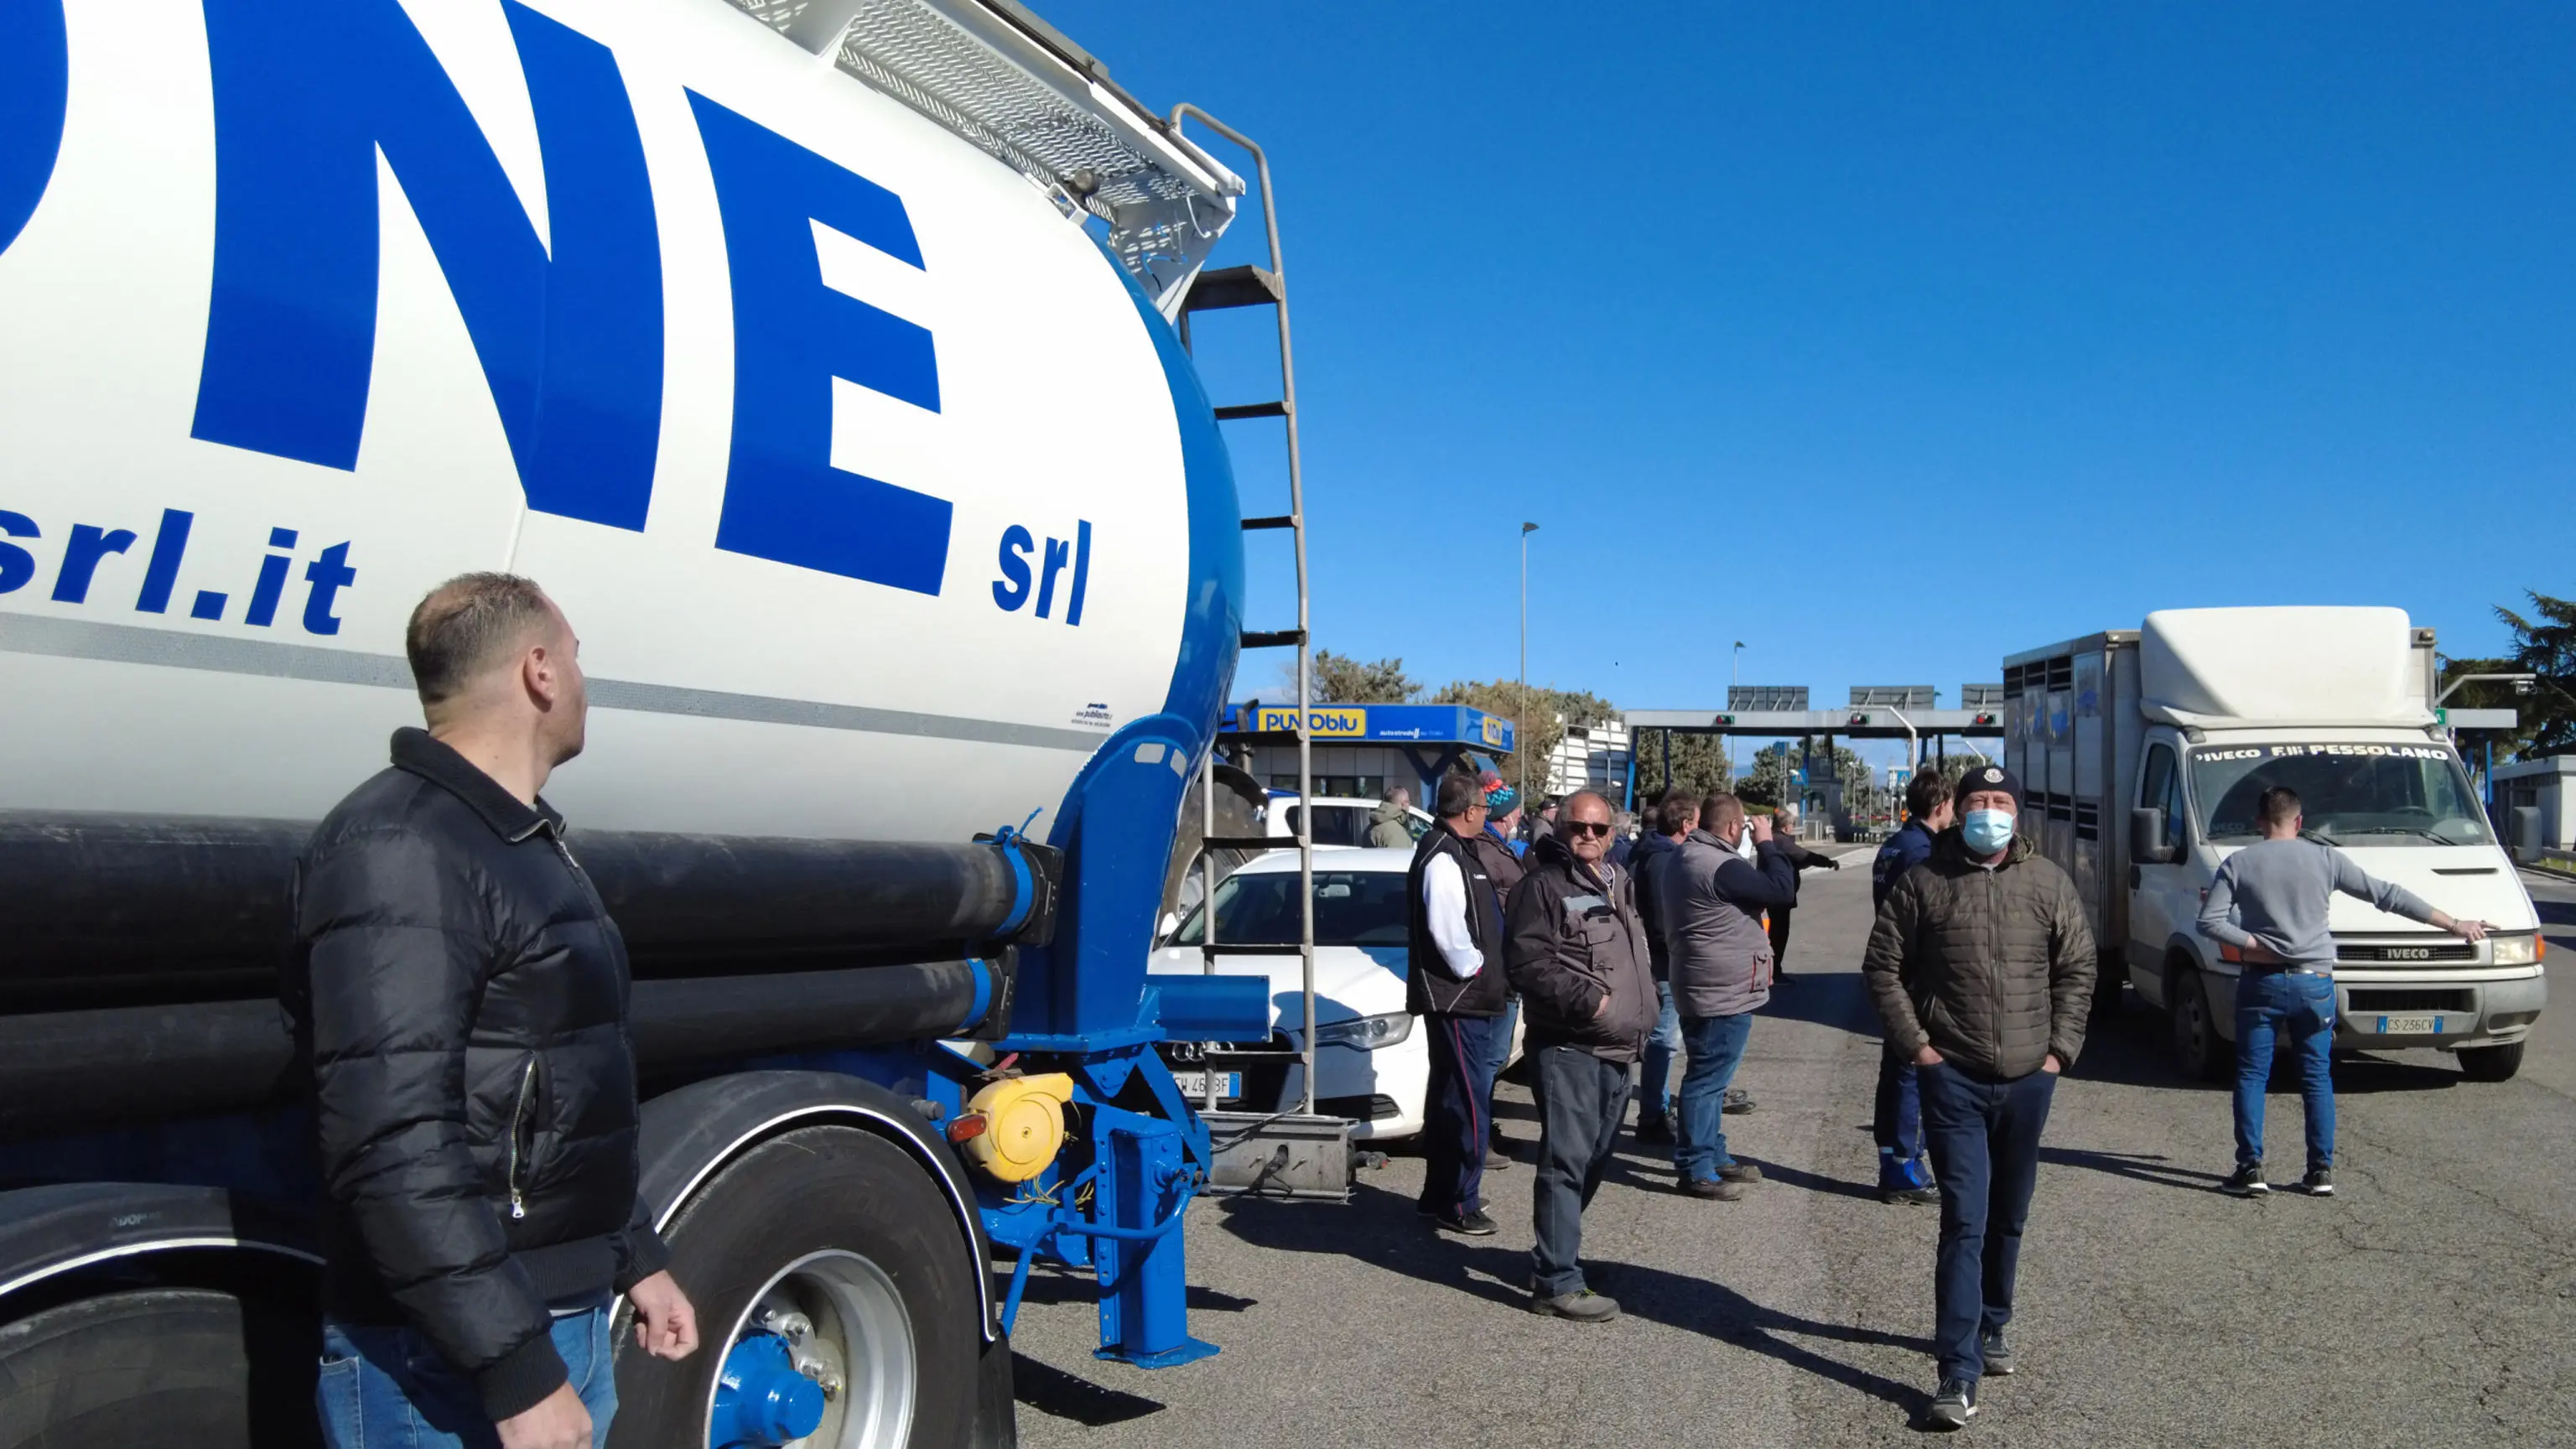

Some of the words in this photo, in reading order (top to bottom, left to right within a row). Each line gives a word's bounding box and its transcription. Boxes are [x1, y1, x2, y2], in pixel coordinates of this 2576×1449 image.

[0, 0, 953, 595] NE
[992, 518, 1092, 627] srl
[2308, 745, 2449, 761] PESSOLANO
[2387, 948, 2429, 959] IVECO
